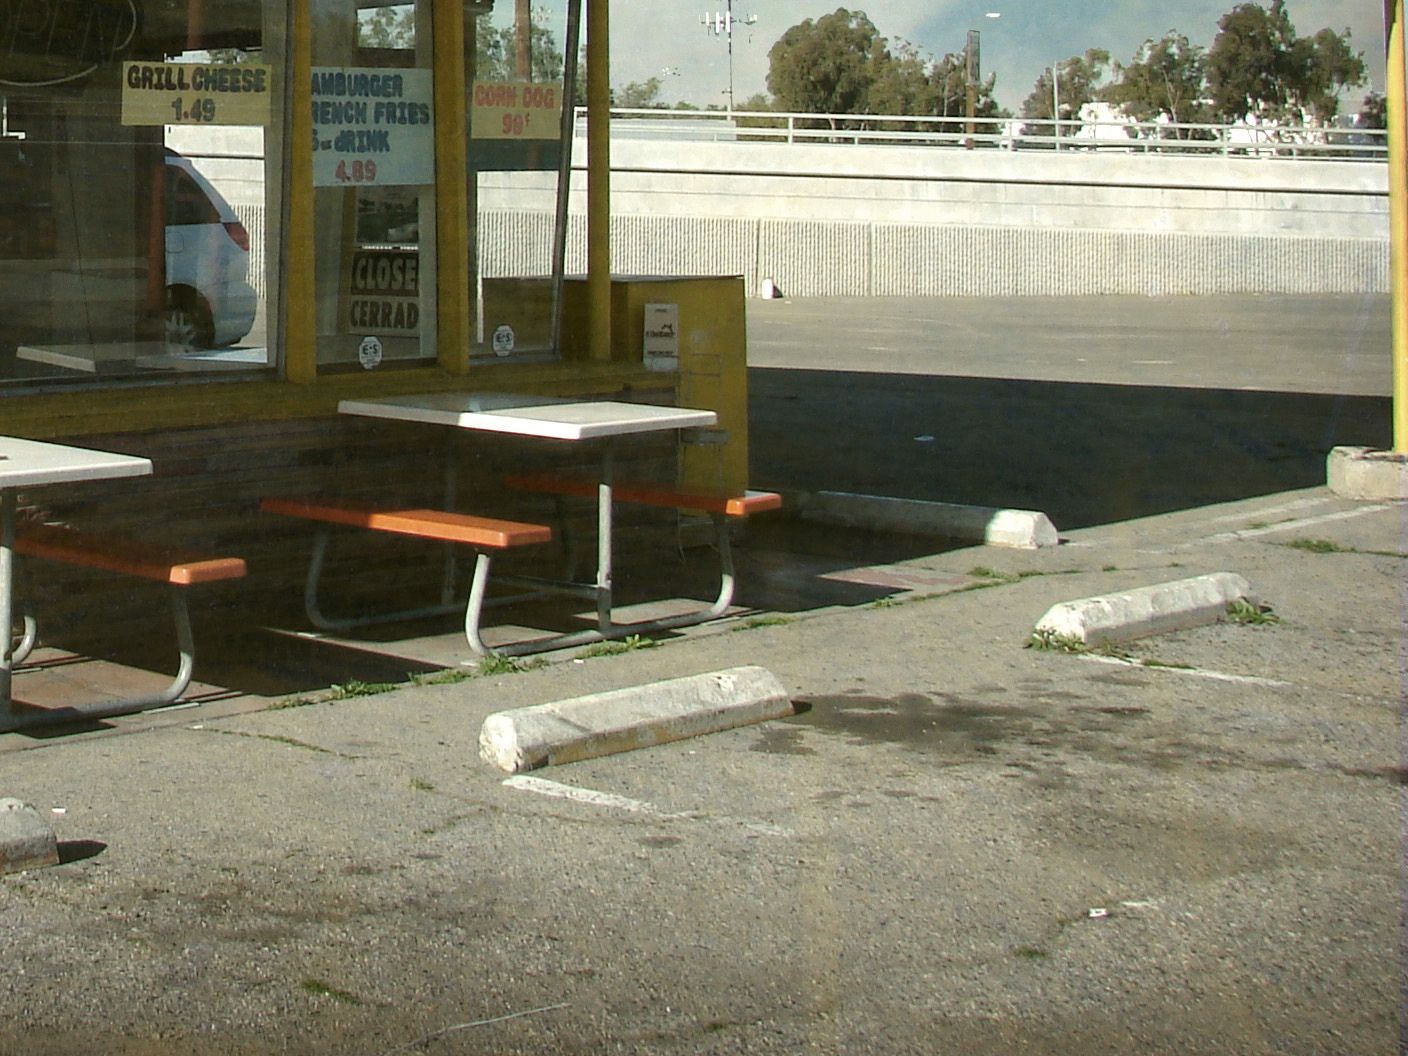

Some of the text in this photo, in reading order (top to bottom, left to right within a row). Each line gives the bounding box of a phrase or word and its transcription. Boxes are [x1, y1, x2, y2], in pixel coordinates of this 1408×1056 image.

[127, 65, 266, 93] GRILL CHEESE
[311, 72, 403, 98] AMBURGER
[171, 97, 216, 122] 1.49
[312, 100, 430, 125] RENCH FRIES
[355, 257, 417, 290] CLOSE
[351, 299, 419, 329] CERRAD
